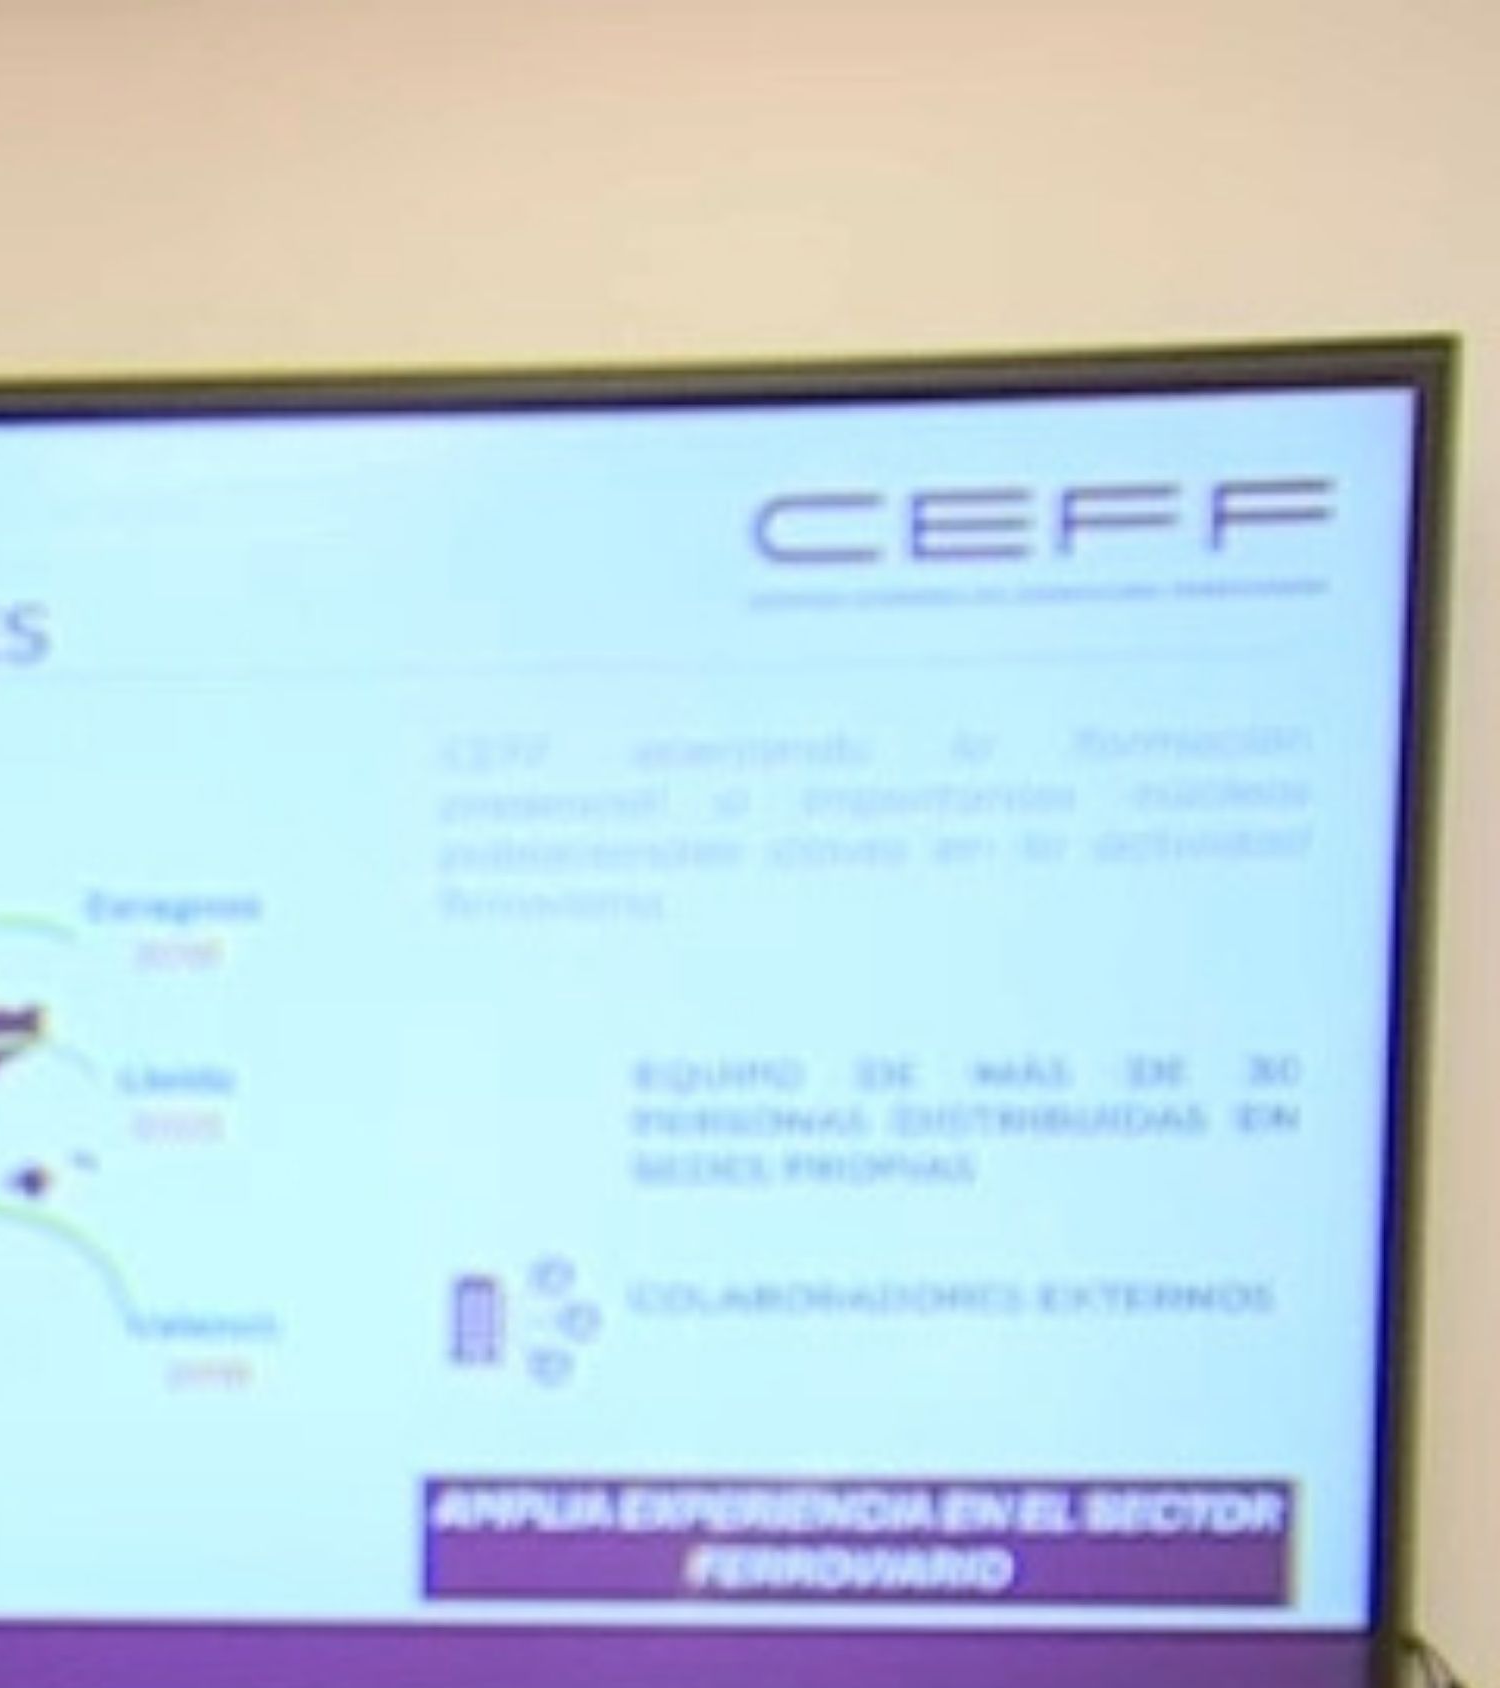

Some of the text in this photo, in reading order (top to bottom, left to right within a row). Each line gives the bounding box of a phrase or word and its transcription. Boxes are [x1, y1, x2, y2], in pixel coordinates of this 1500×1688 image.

[750, 477, 1336, 564] CEFF
[943, 1488, 1014, 1533] EN
[1020, 1488, 1077, 1533] EL
